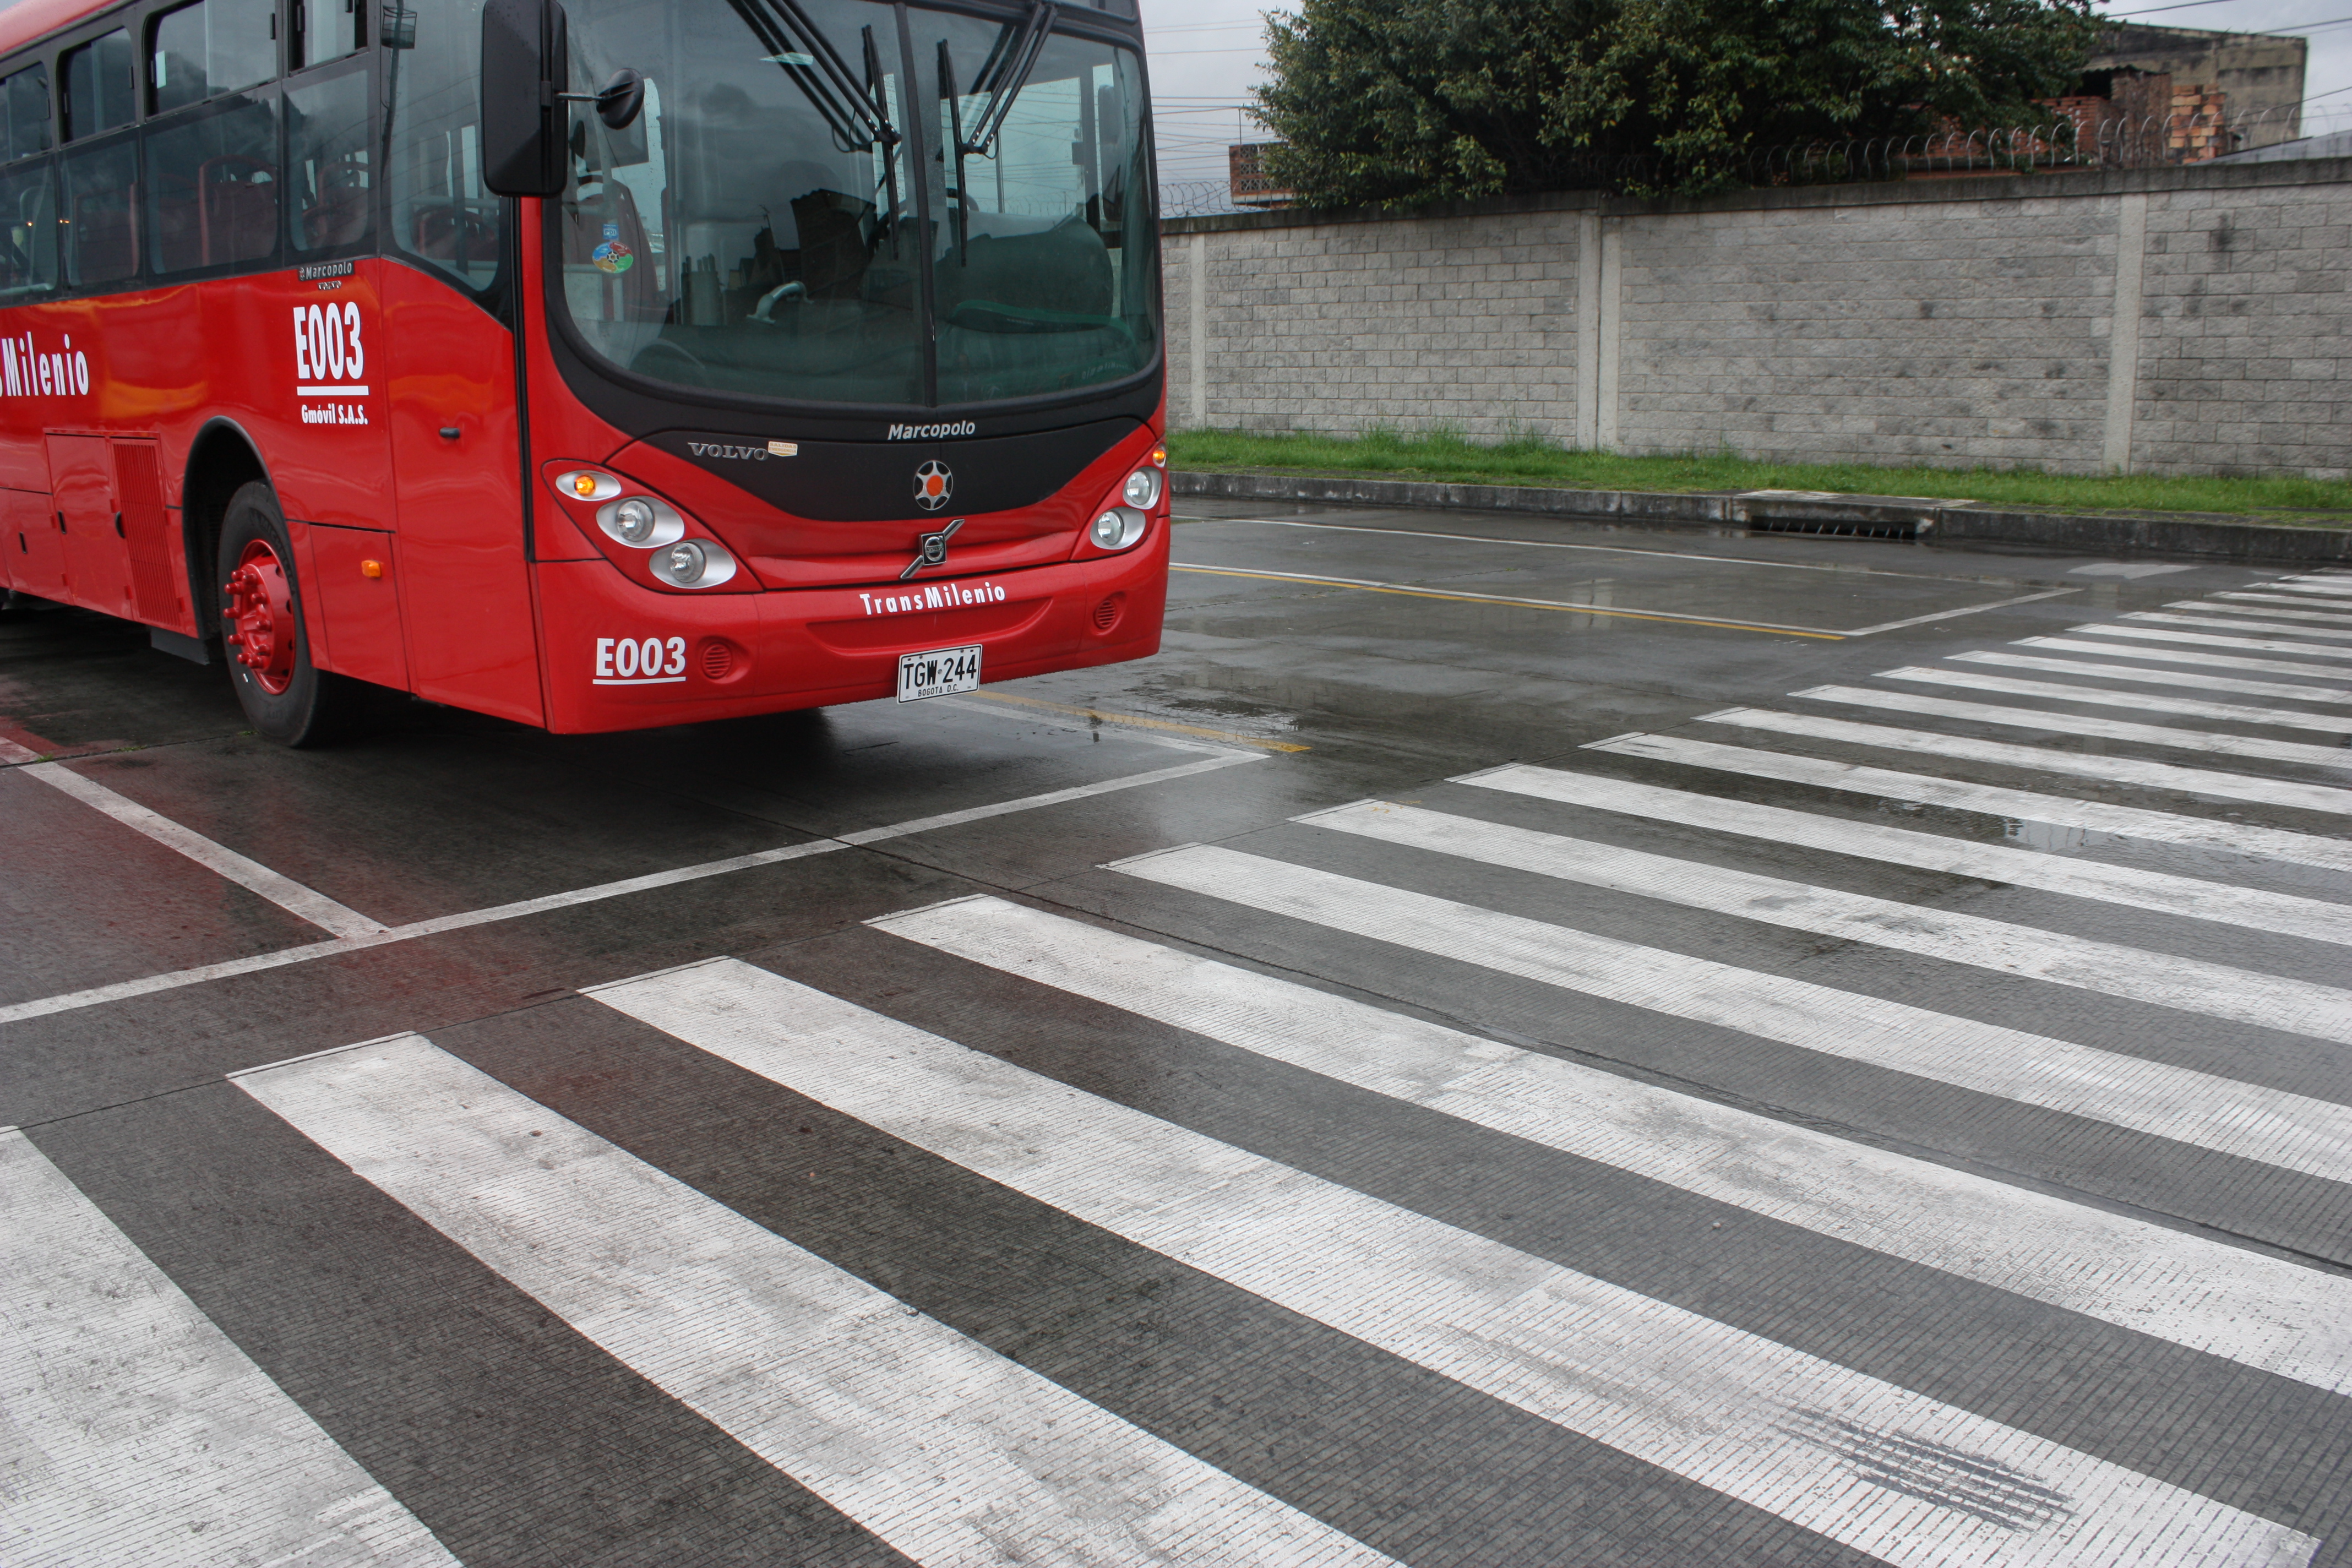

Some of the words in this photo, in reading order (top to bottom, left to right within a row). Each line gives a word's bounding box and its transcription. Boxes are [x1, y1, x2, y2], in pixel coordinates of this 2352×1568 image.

[306, 262, 352, 280] Marcopolo
[293, 301, 364, 380] E003
[0, 331, 89, 397] Milenio
[301, 403, 336, 424] Gmóvil
[338, 405, 368, 425] S.A.S.
[888, 420, 976, 440] Marcopolo
[688, 442, 769, 461] VOLVO
[859, 581, 1005, 615] TransMilenio
[596, 636, 686, 677] E003
[903, 660, 938, 690] TGW
[943, 654, 977, 683] 244
[918, 687, 943, 697] BOGOTA
[947, 684, 959, 693] D.C.
